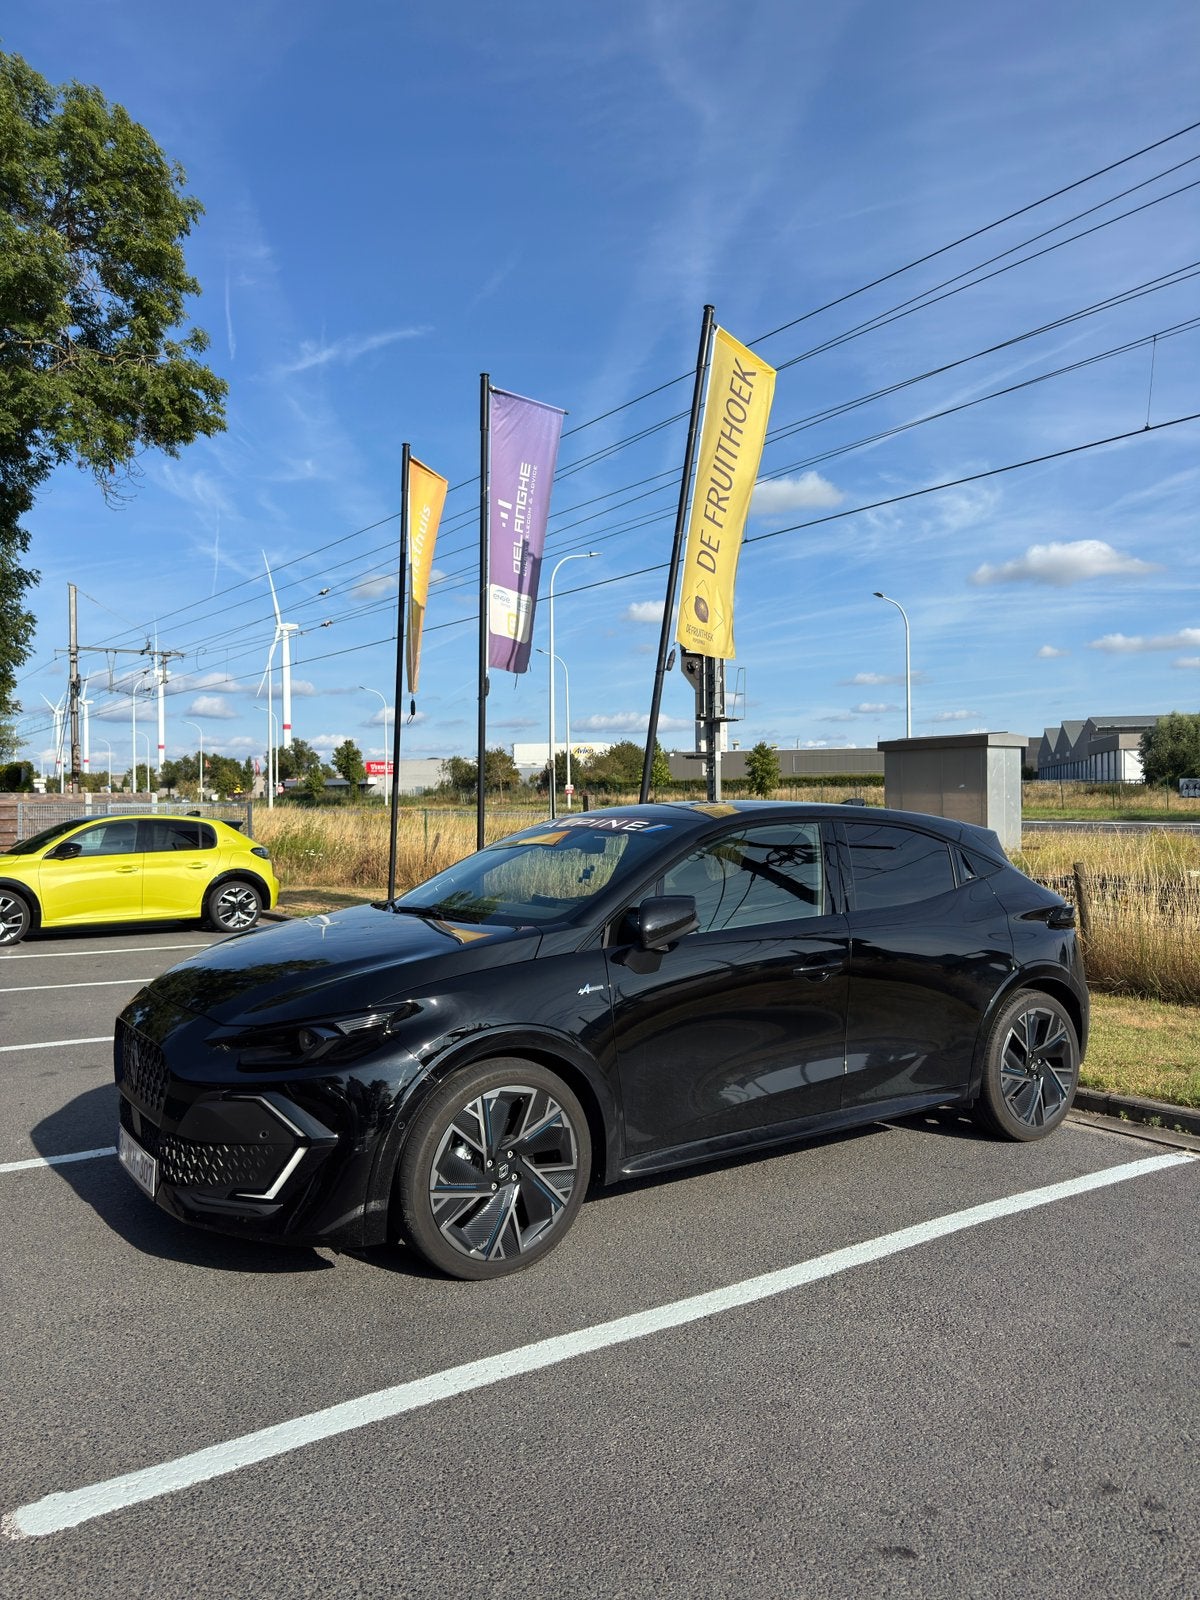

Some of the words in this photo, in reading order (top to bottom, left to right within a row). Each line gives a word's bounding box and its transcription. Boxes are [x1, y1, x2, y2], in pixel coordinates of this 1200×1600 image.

[530, 465, 538, 495] ADVICE
[704, 358, 757, 529] FRUITHOEK
[513, 462, 531, 574] DELANGHE
[697, 529, 721, 574] DE
